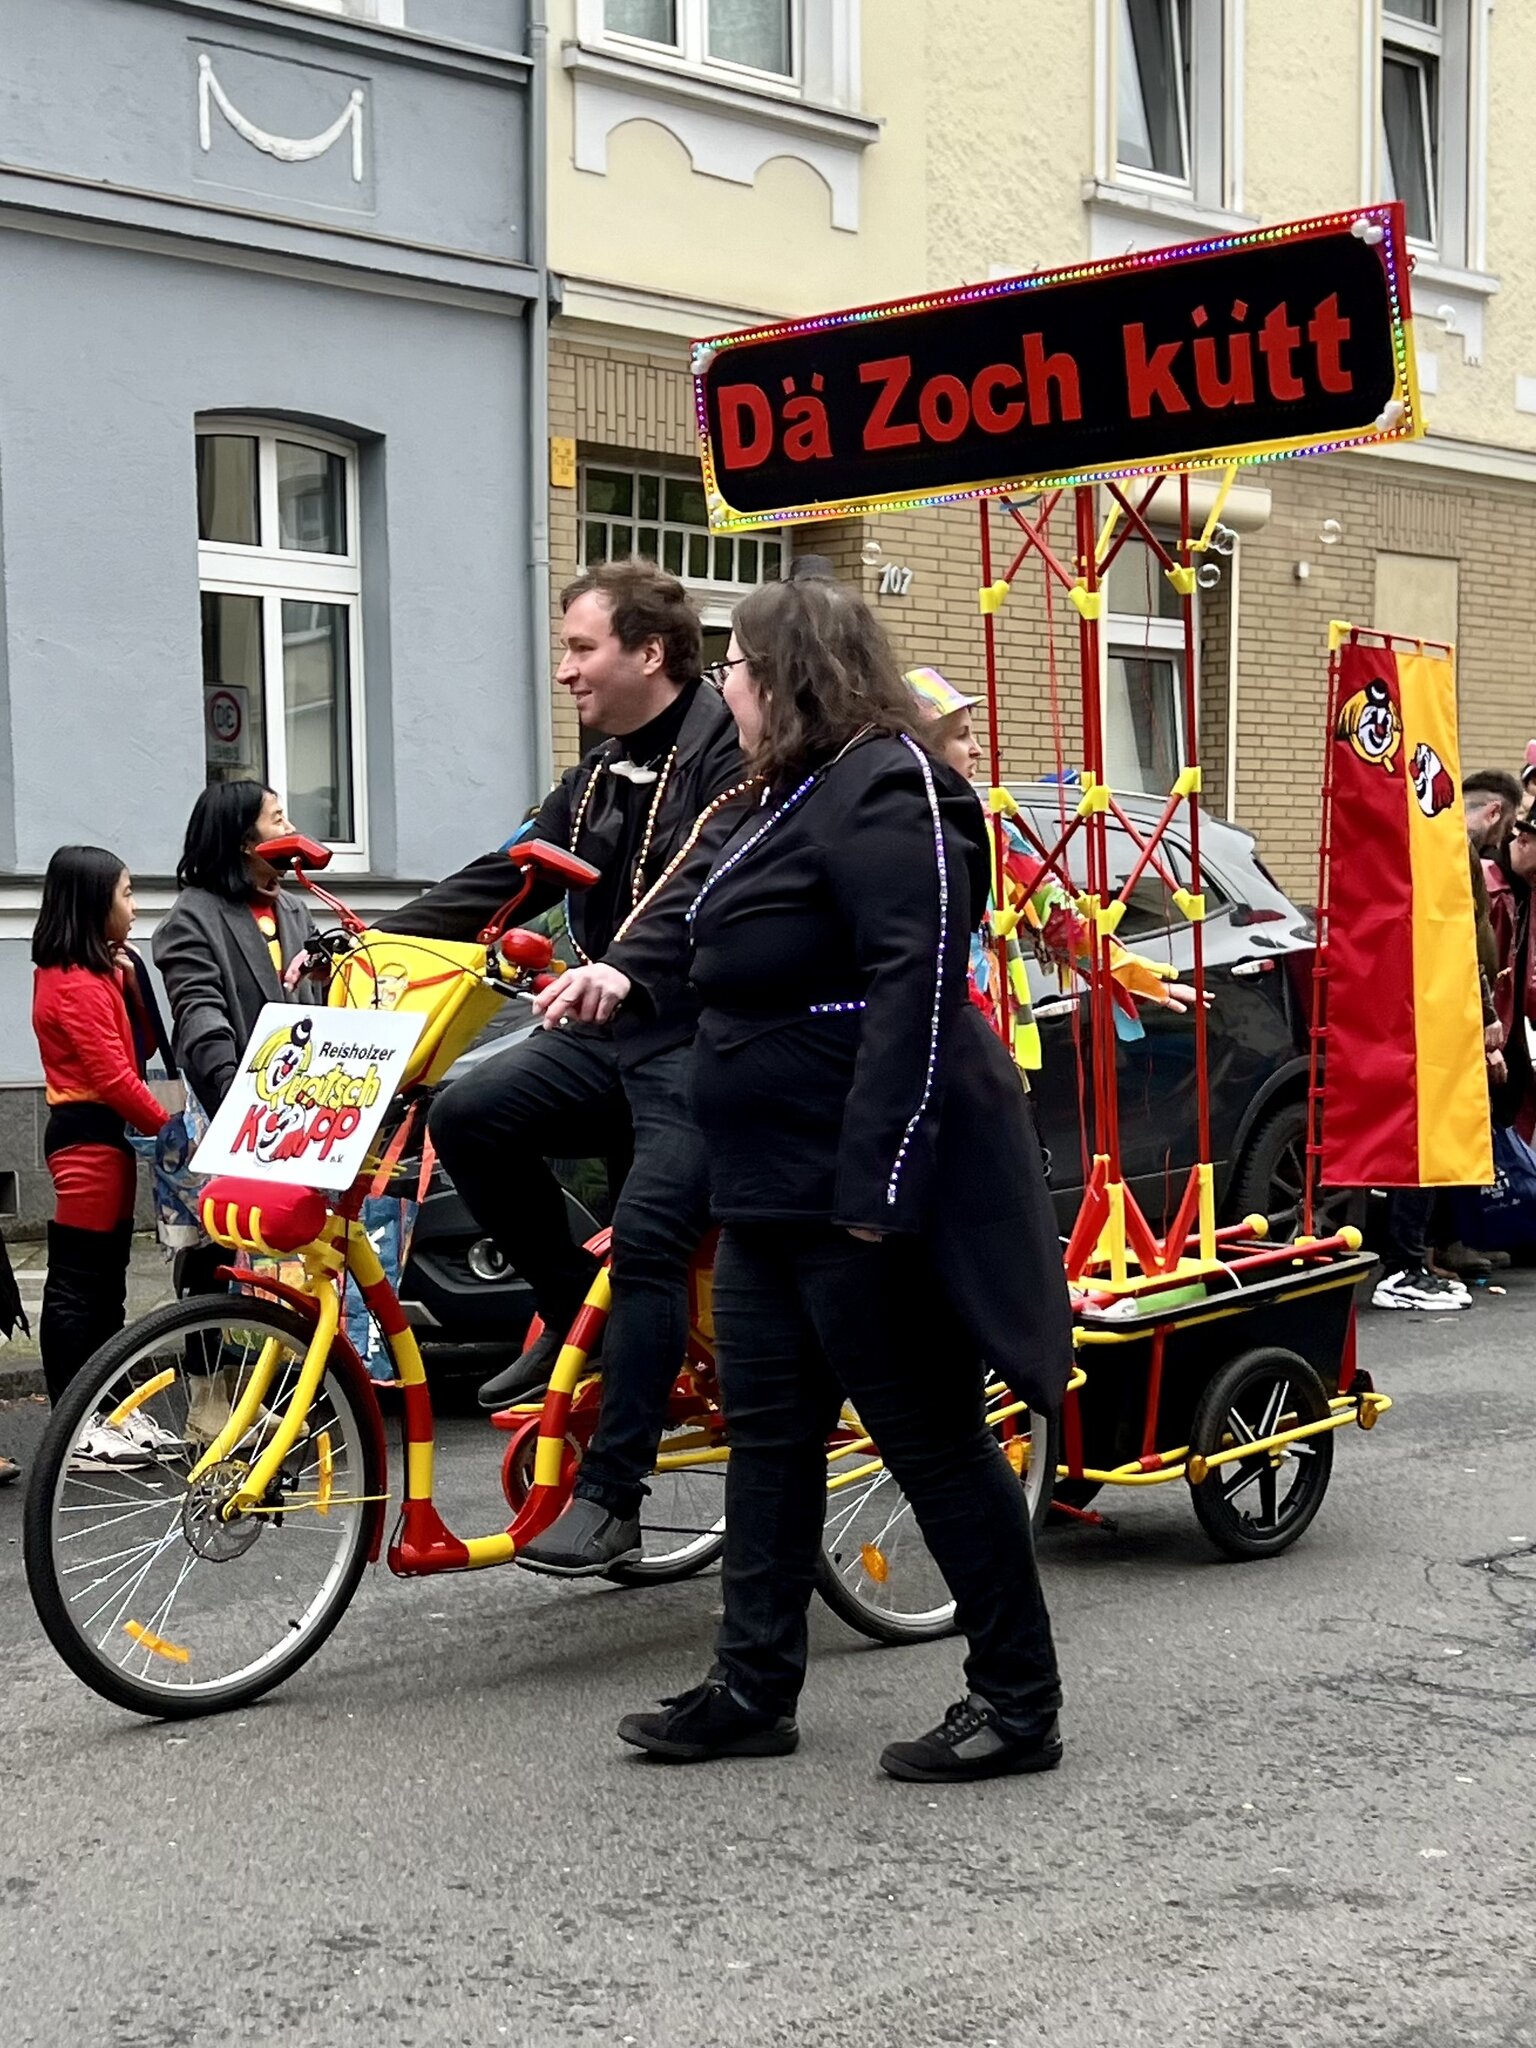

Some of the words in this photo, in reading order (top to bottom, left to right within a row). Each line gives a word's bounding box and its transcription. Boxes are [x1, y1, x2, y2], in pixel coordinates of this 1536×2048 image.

[717, 373, 833, 470] Dä
[858, 332, 1082, 450] Zoch
[1122, 291, 1354, 418] kütt
[878, 562, 913, 594] 107
[253, 1027, 382, 1111] Quatsch
[318, 1041, 396, 1061] Reisholzer
